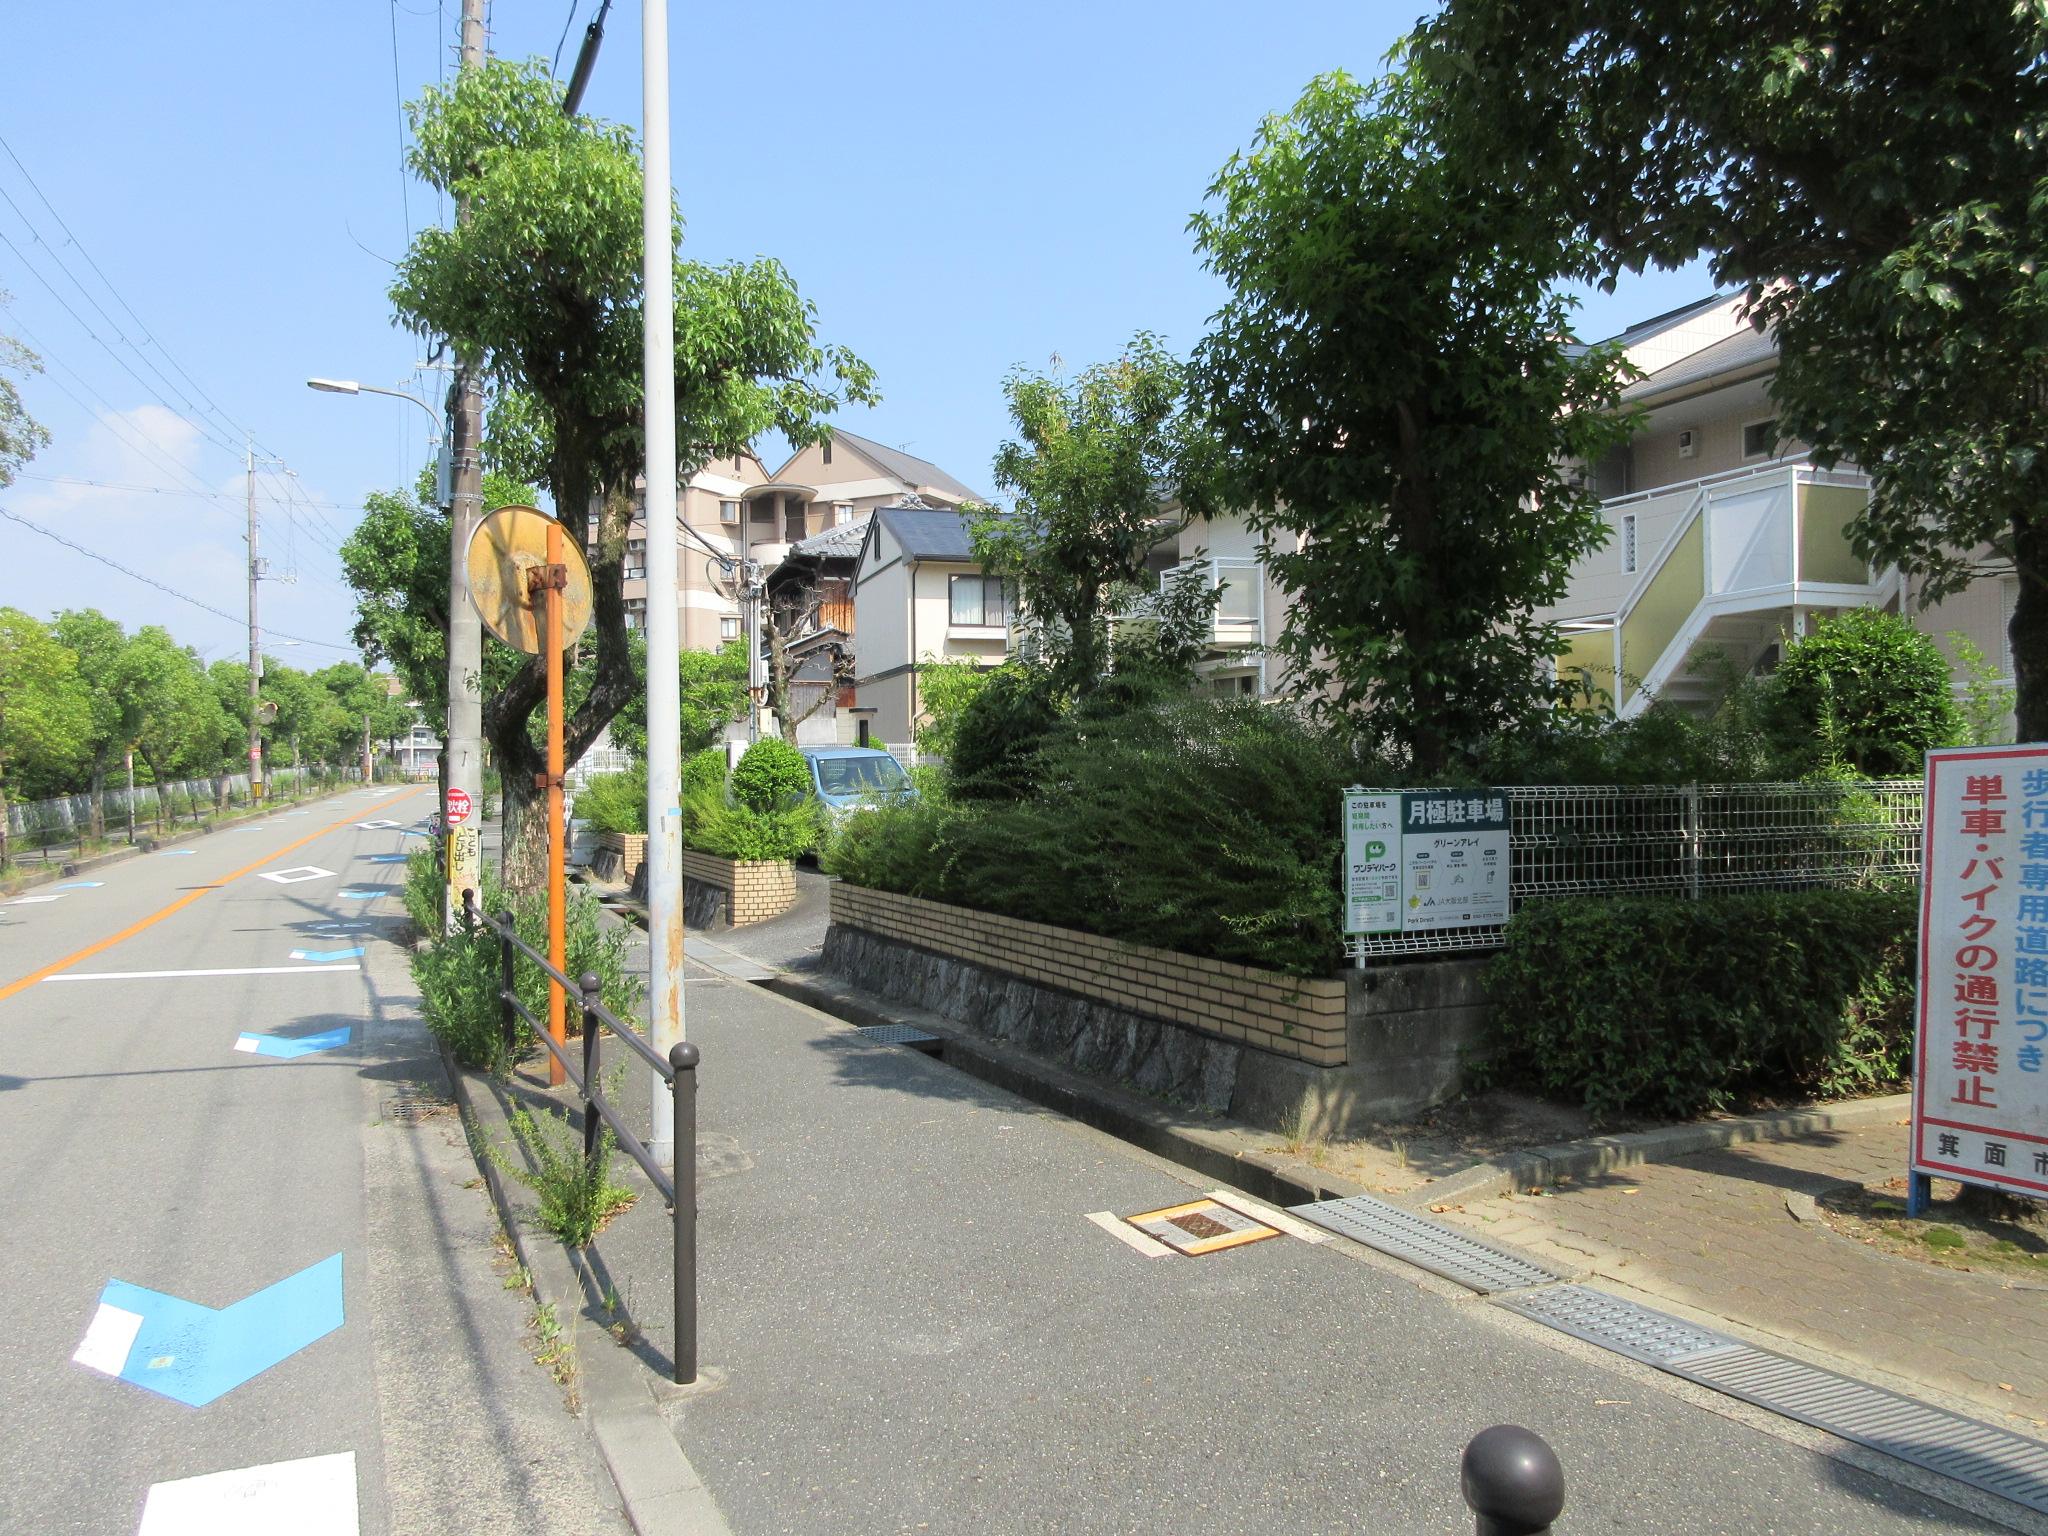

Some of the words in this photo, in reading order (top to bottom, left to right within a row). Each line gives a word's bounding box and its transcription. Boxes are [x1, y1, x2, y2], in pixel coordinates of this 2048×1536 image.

[1408, 798, 1504, 825] 月極駐車場
[1434, 838, 1480, 848] グリーンアレイ
[1951, 775, 2008, 1109] 単車・バイクの通行禁止
[2014, 769, 2048, 1073] 歩行者専用道路につき
[1938, 1133, 2048, 1176] 箕面市
